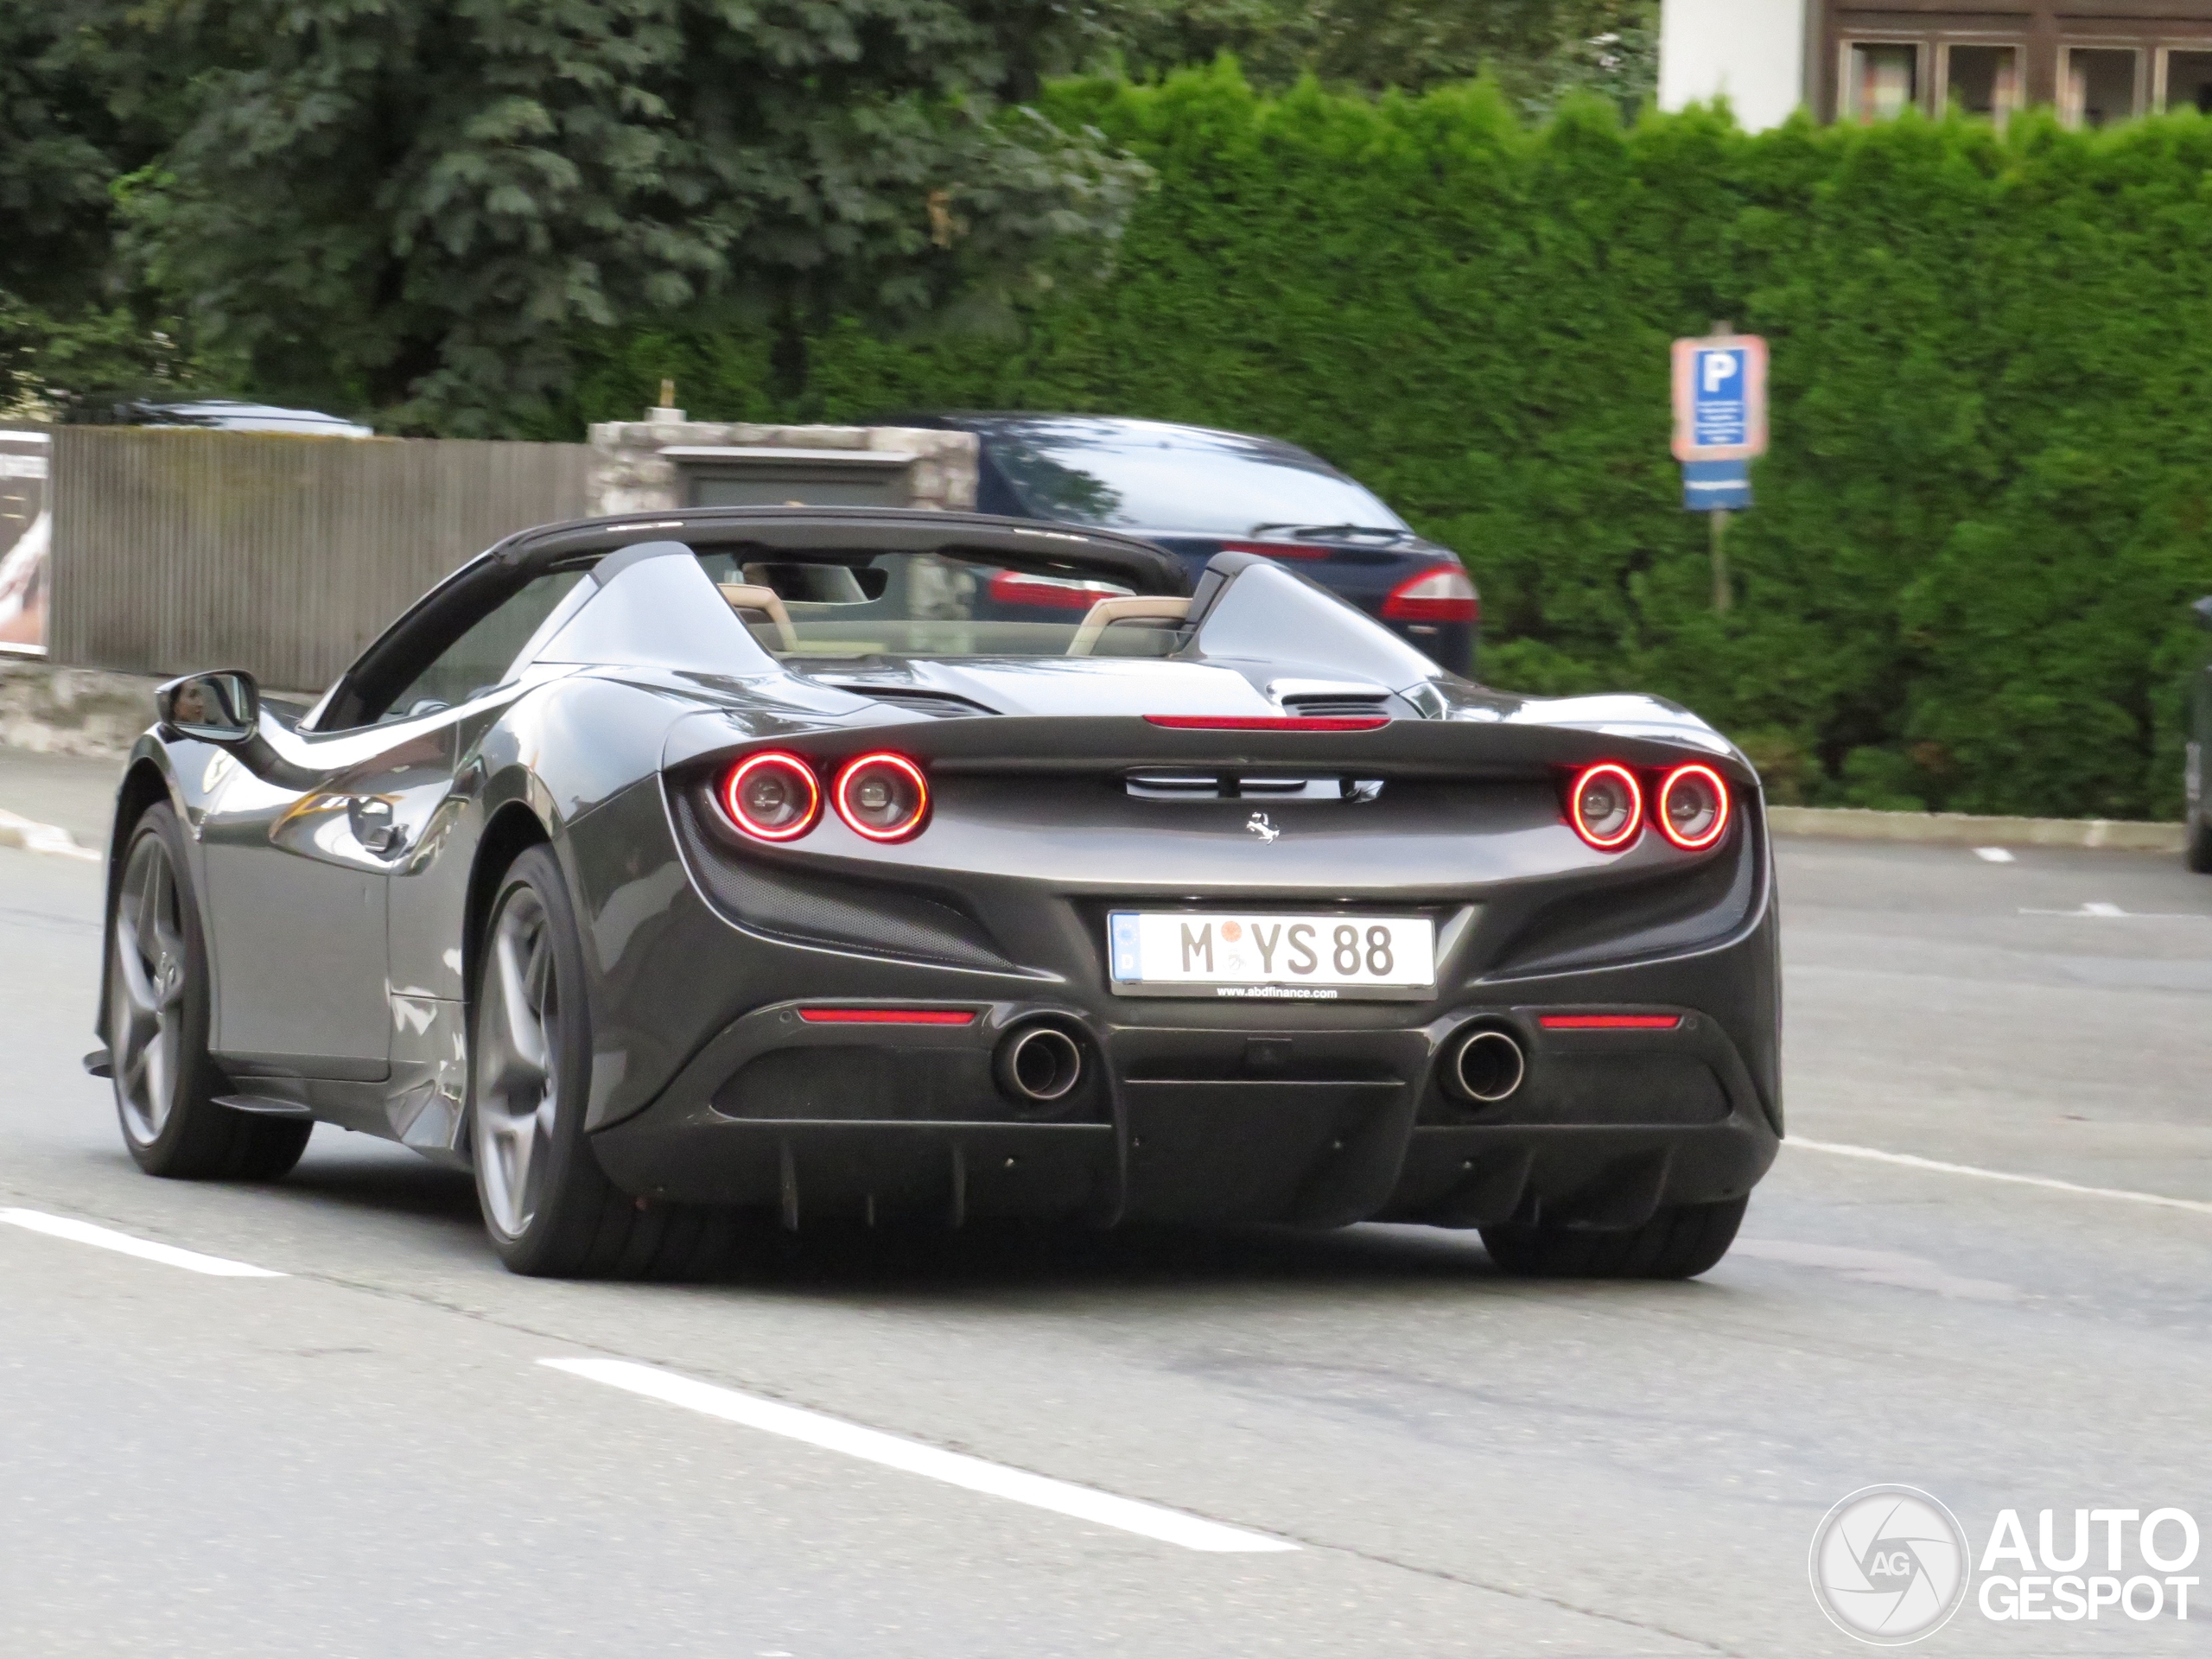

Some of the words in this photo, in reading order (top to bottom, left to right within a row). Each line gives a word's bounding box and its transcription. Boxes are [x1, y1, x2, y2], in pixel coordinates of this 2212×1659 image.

[1703, 353, 1738, 392] P
[1180, 923, 1214, 973] M
[1251, 923, 1319, 976] YS
[1332, 925, 1394, 976] 88
[1217, 986, 1338, 999] www.abdfinance.com
